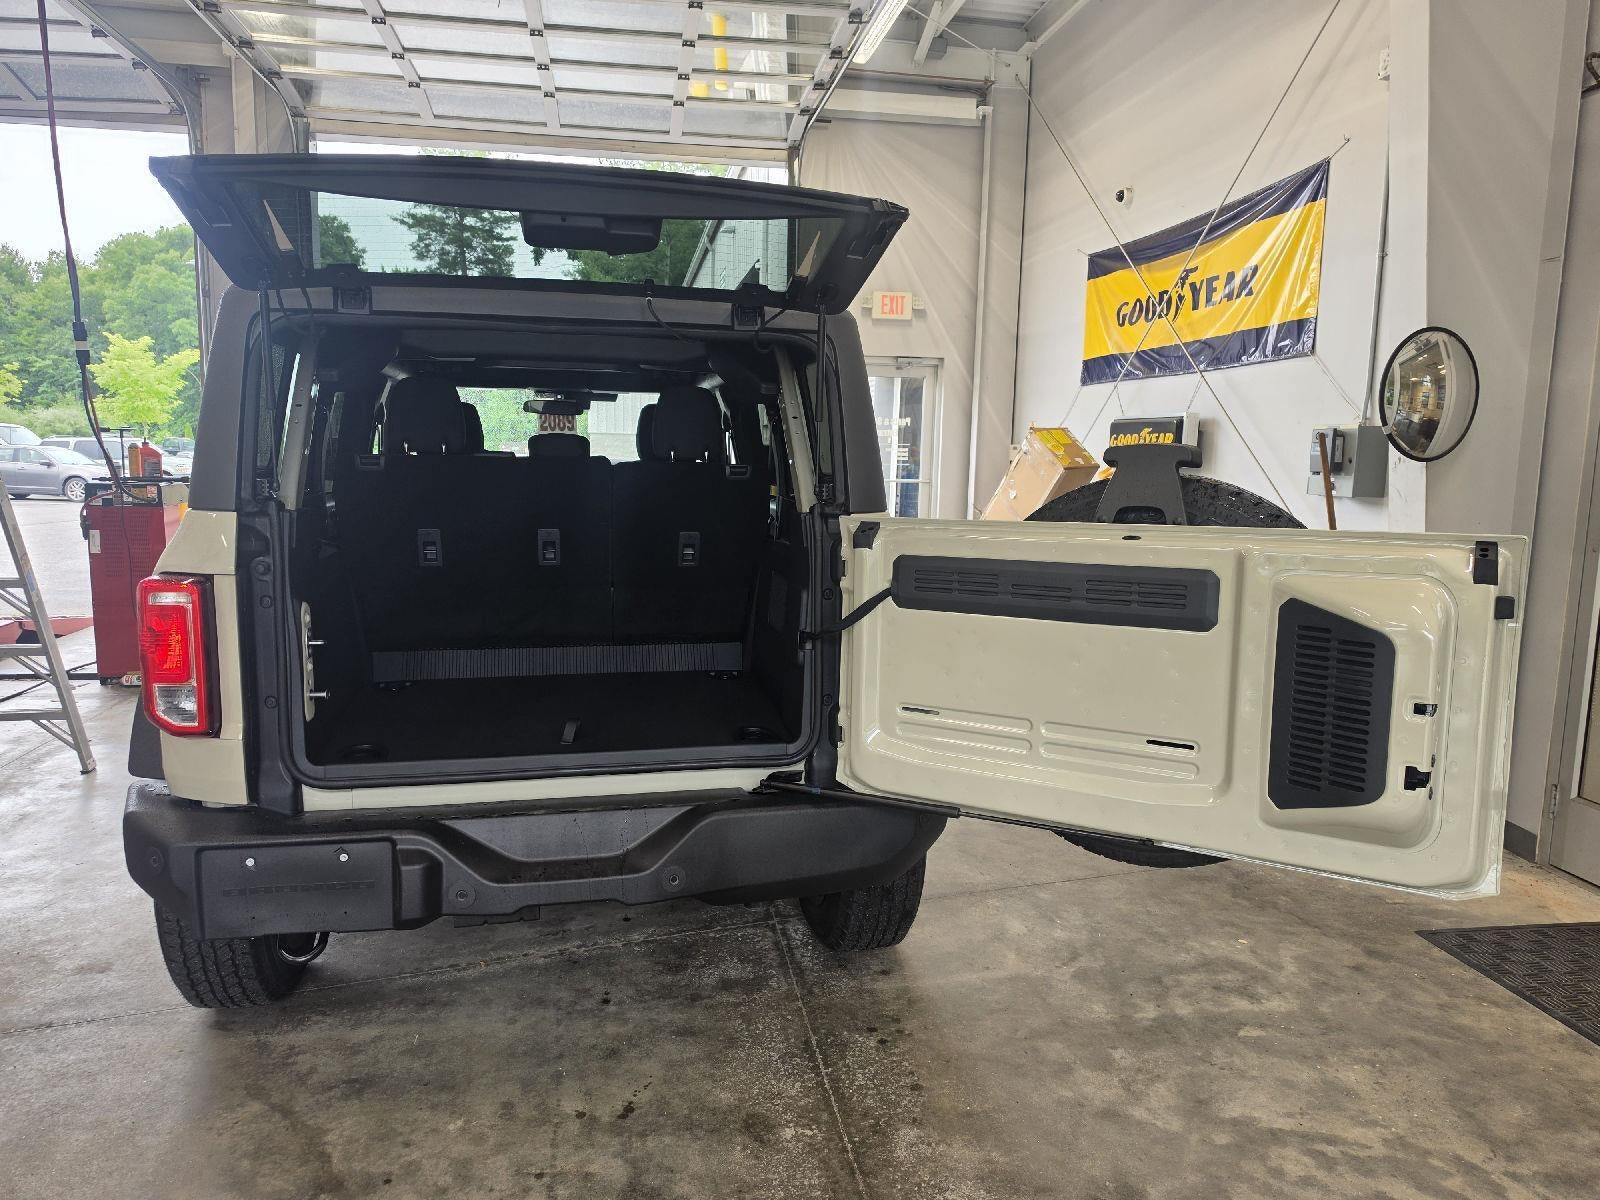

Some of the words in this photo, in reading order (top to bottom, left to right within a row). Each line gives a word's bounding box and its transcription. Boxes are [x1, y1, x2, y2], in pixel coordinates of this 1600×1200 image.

[881, 295, 906, 315] EXIT
[1116, 264, 1260, 328] GOODYEAR
[1110, 427, 1173, 447] GOODYEAR
